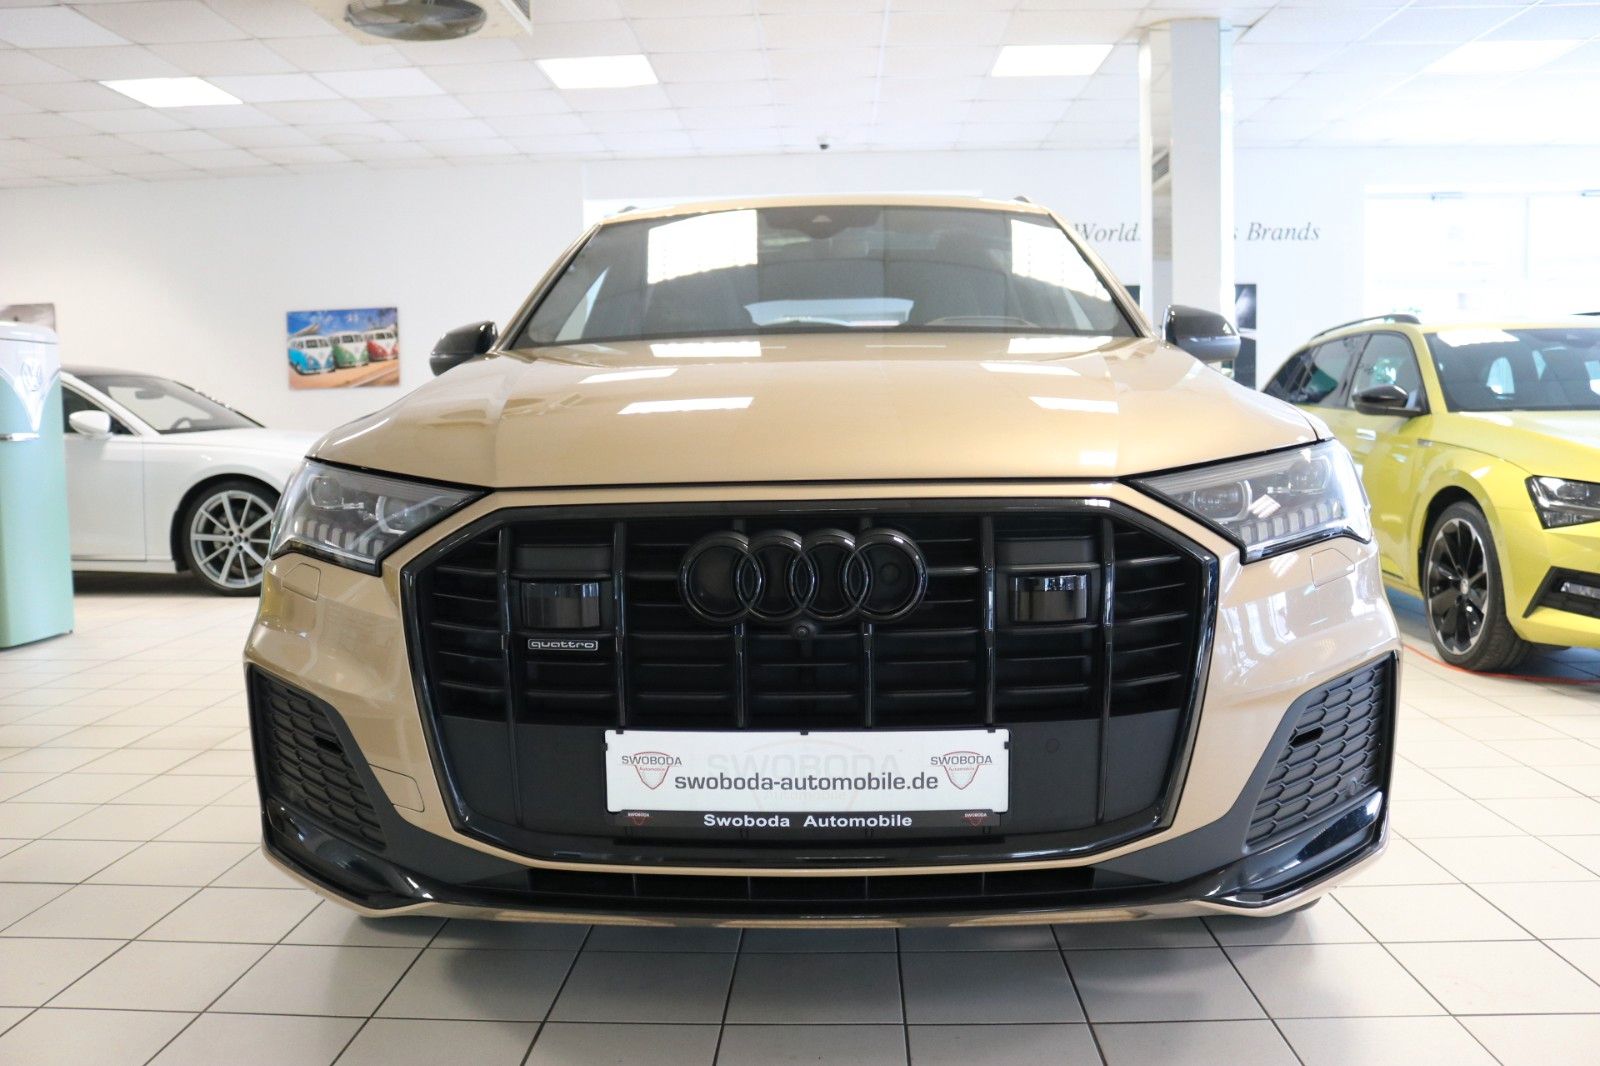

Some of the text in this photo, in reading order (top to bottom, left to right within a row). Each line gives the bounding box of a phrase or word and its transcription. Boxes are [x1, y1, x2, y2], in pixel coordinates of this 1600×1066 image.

[1074, 221, 1141, 242] World
[1246, 221, 1320, 241] Brands
[531, 641, 595, 649] quattro
[621, 755, 682, 766] SWOBODA
[930, 755, 993, 766] SWOBODA
[674, 772, 939, 790] swoboda-automobile.de
[703, 814, 913, 827] Swoboda Automobile
